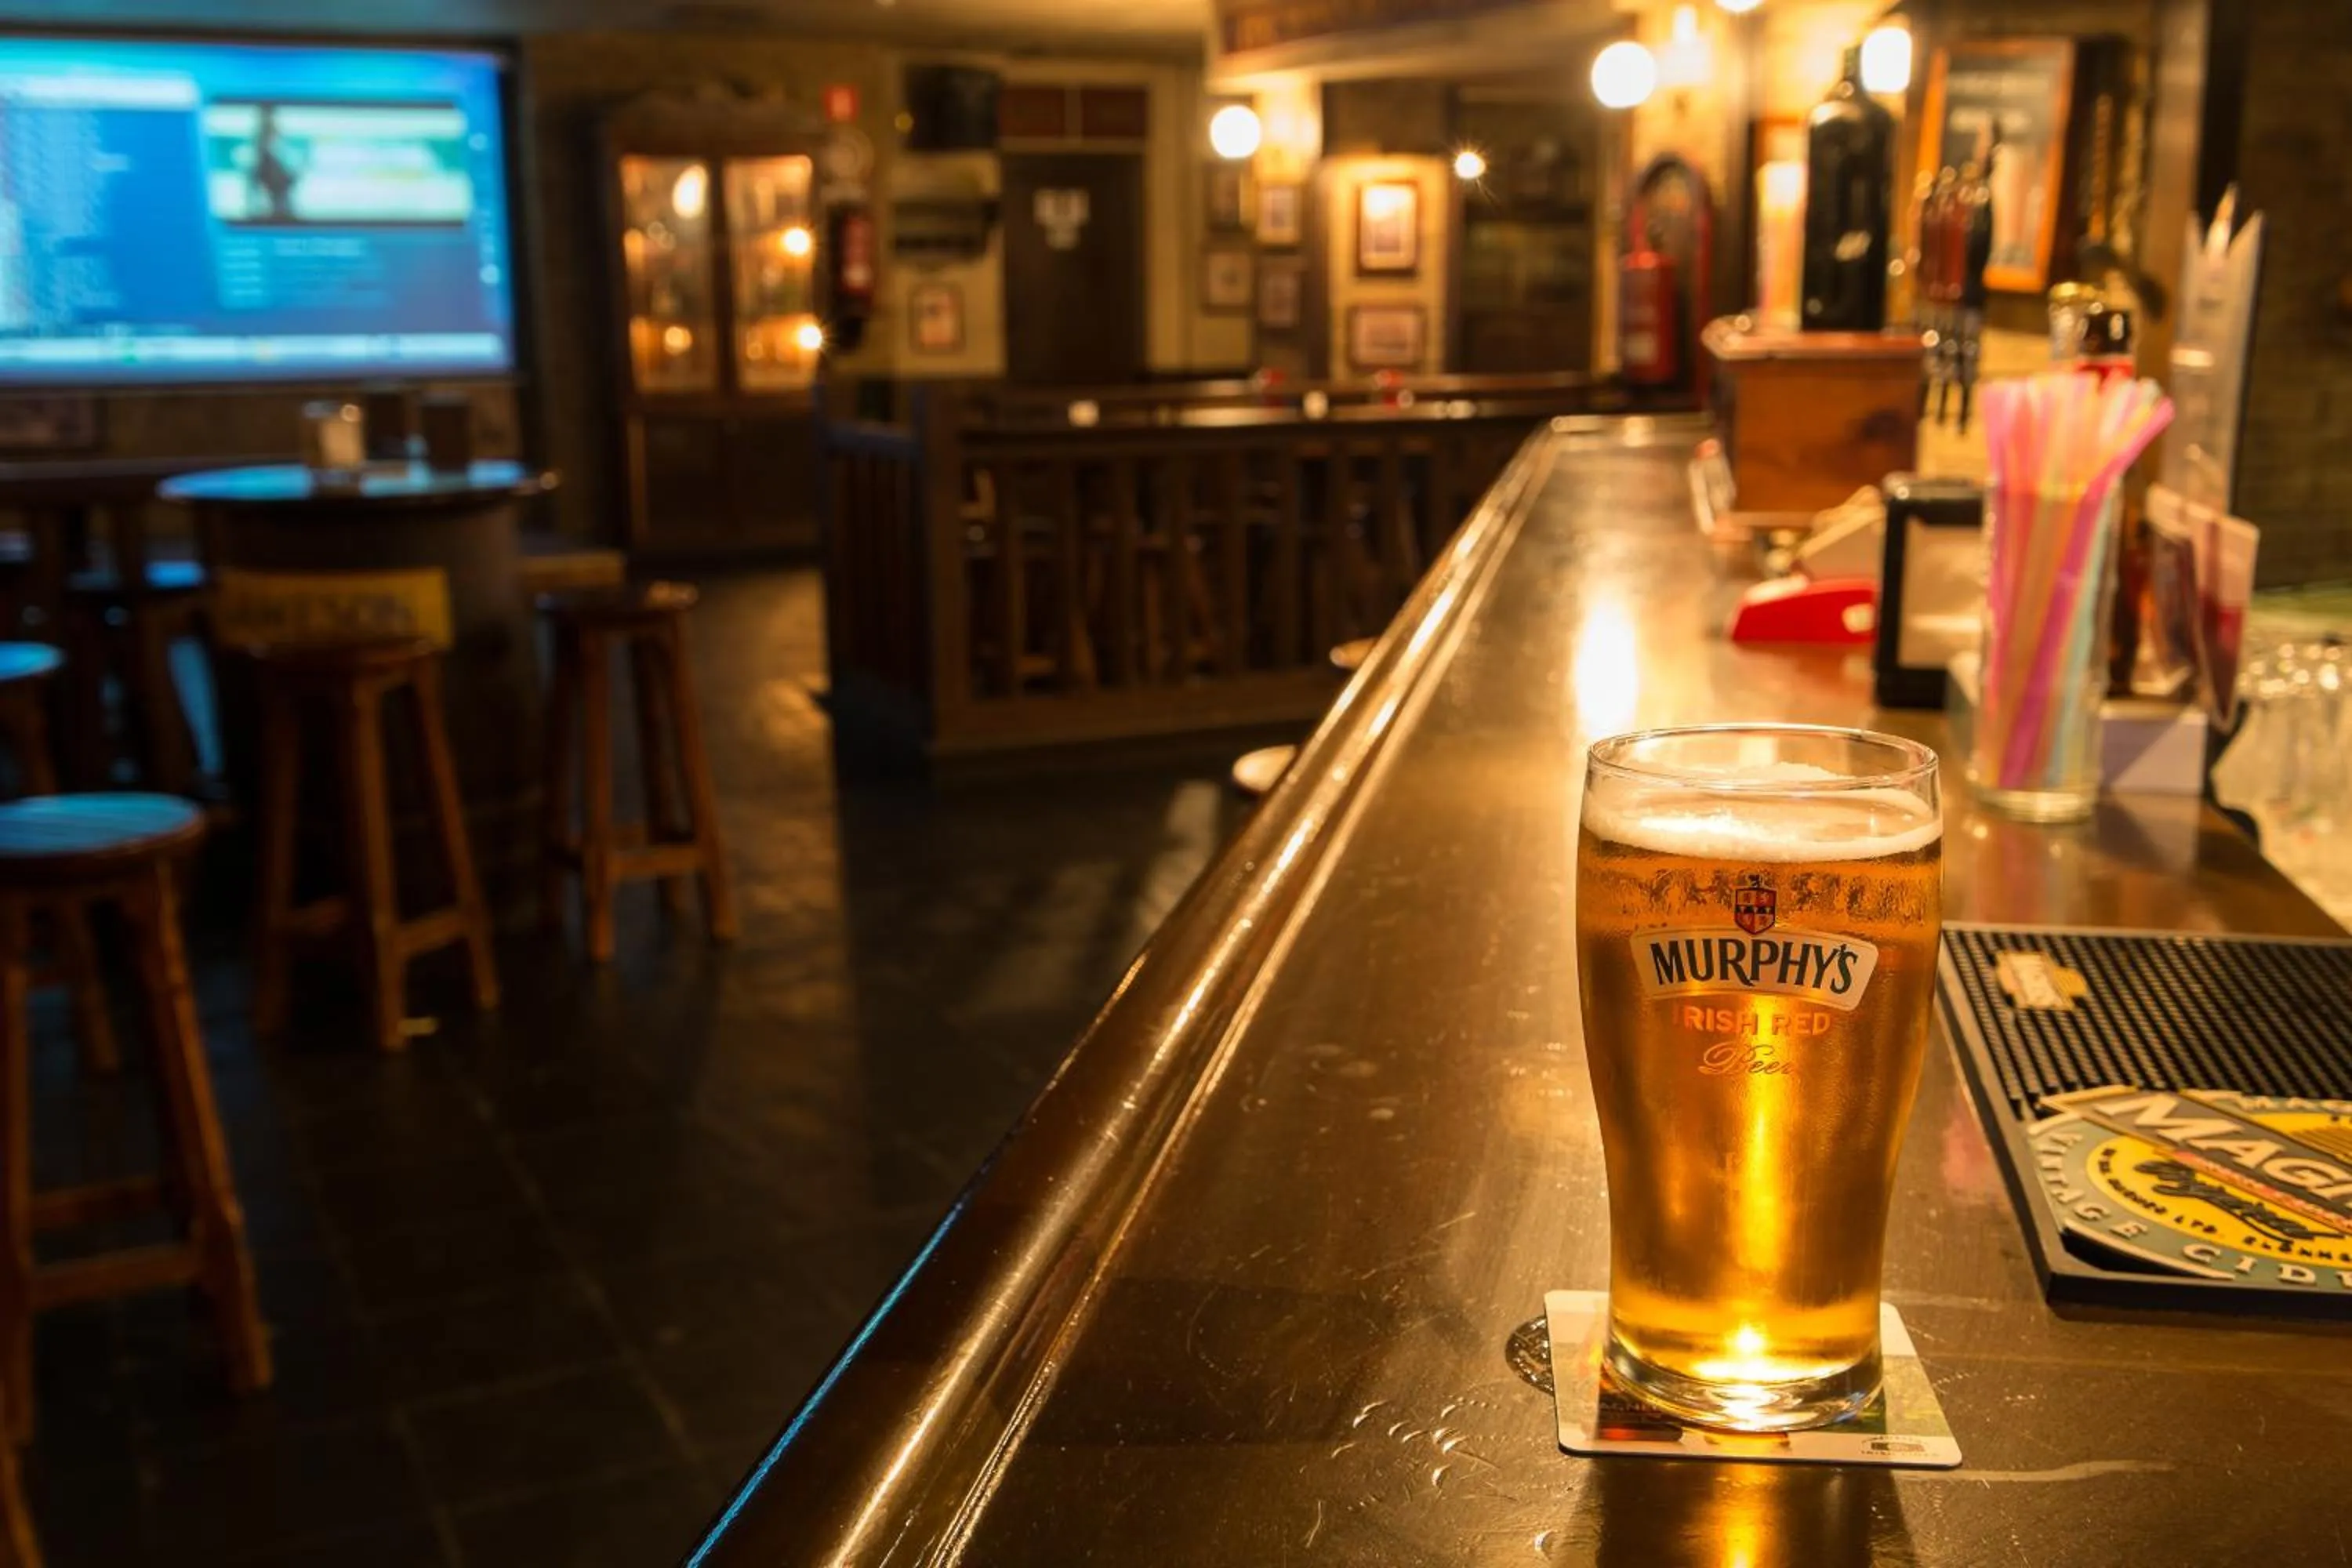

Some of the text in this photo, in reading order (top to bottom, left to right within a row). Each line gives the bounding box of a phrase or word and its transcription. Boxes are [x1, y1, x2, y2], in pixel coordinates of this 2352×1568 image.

[1650, 938, 1857, 995] MURPHY'S
[1673, 1004, 1831, 1036] IRISH RED
